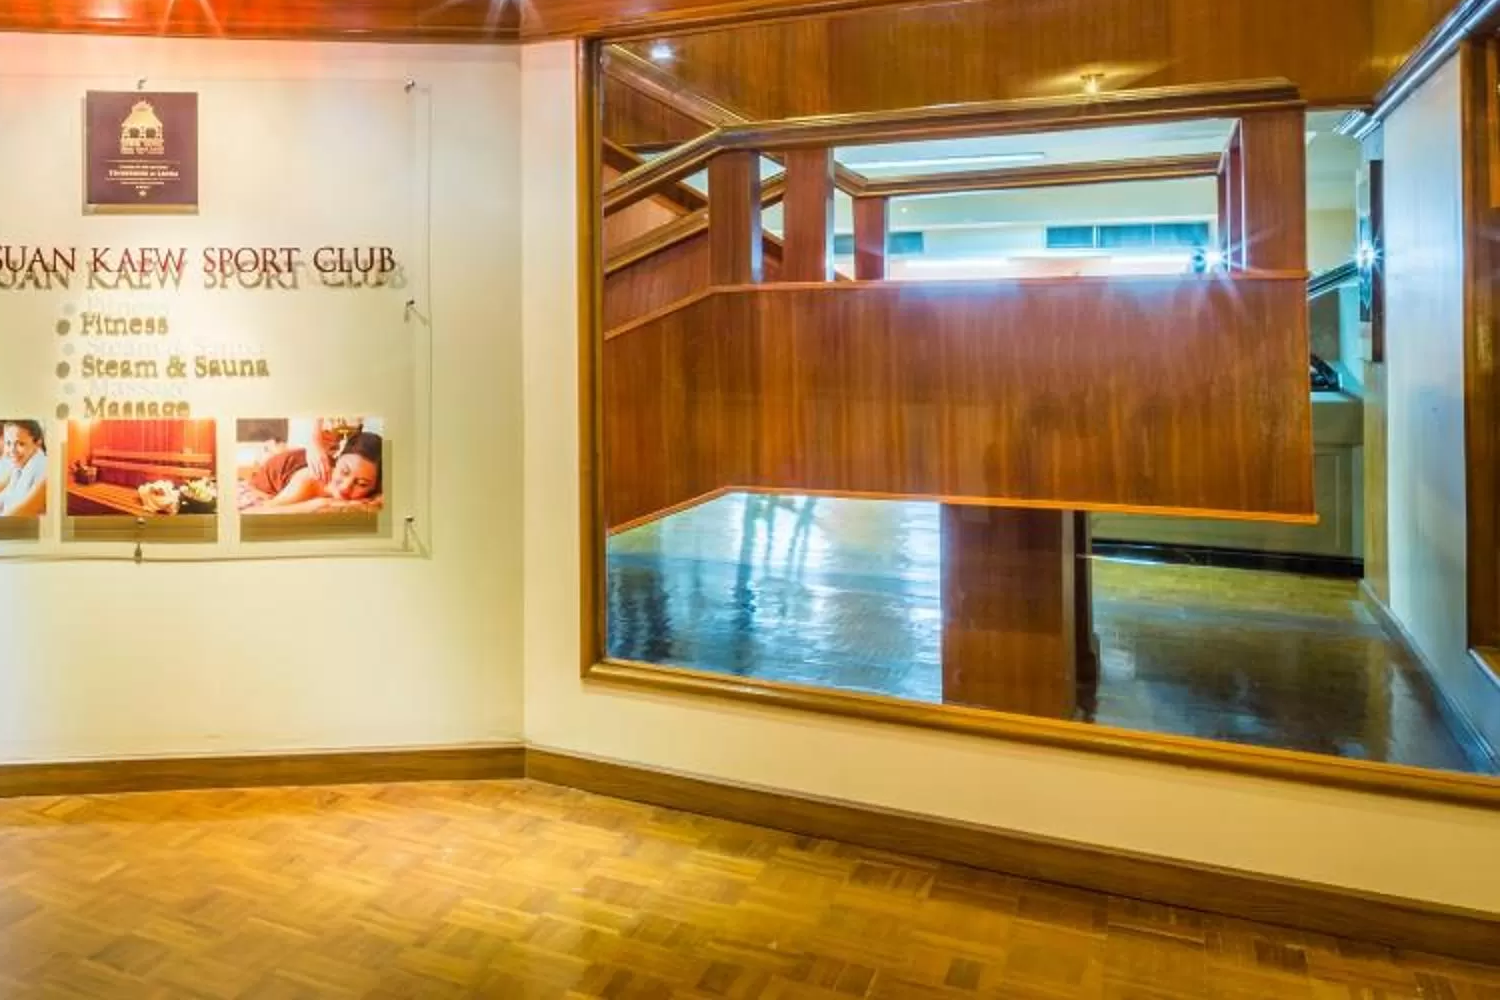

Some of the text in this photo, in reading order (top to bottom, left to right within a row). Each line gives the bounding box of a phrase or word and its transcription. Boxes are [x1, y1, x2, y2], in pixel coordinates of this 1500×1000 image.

[91, 247, 187, 272] KAEW
[203, 247, 299, 273] SPORT
[313, 247, 396, 273] CLUB
[80, 312, 168, 336] Fitness
[82, 354, 269, 378] Steam & Sauna
[84, 396, 190, 418] Massage
